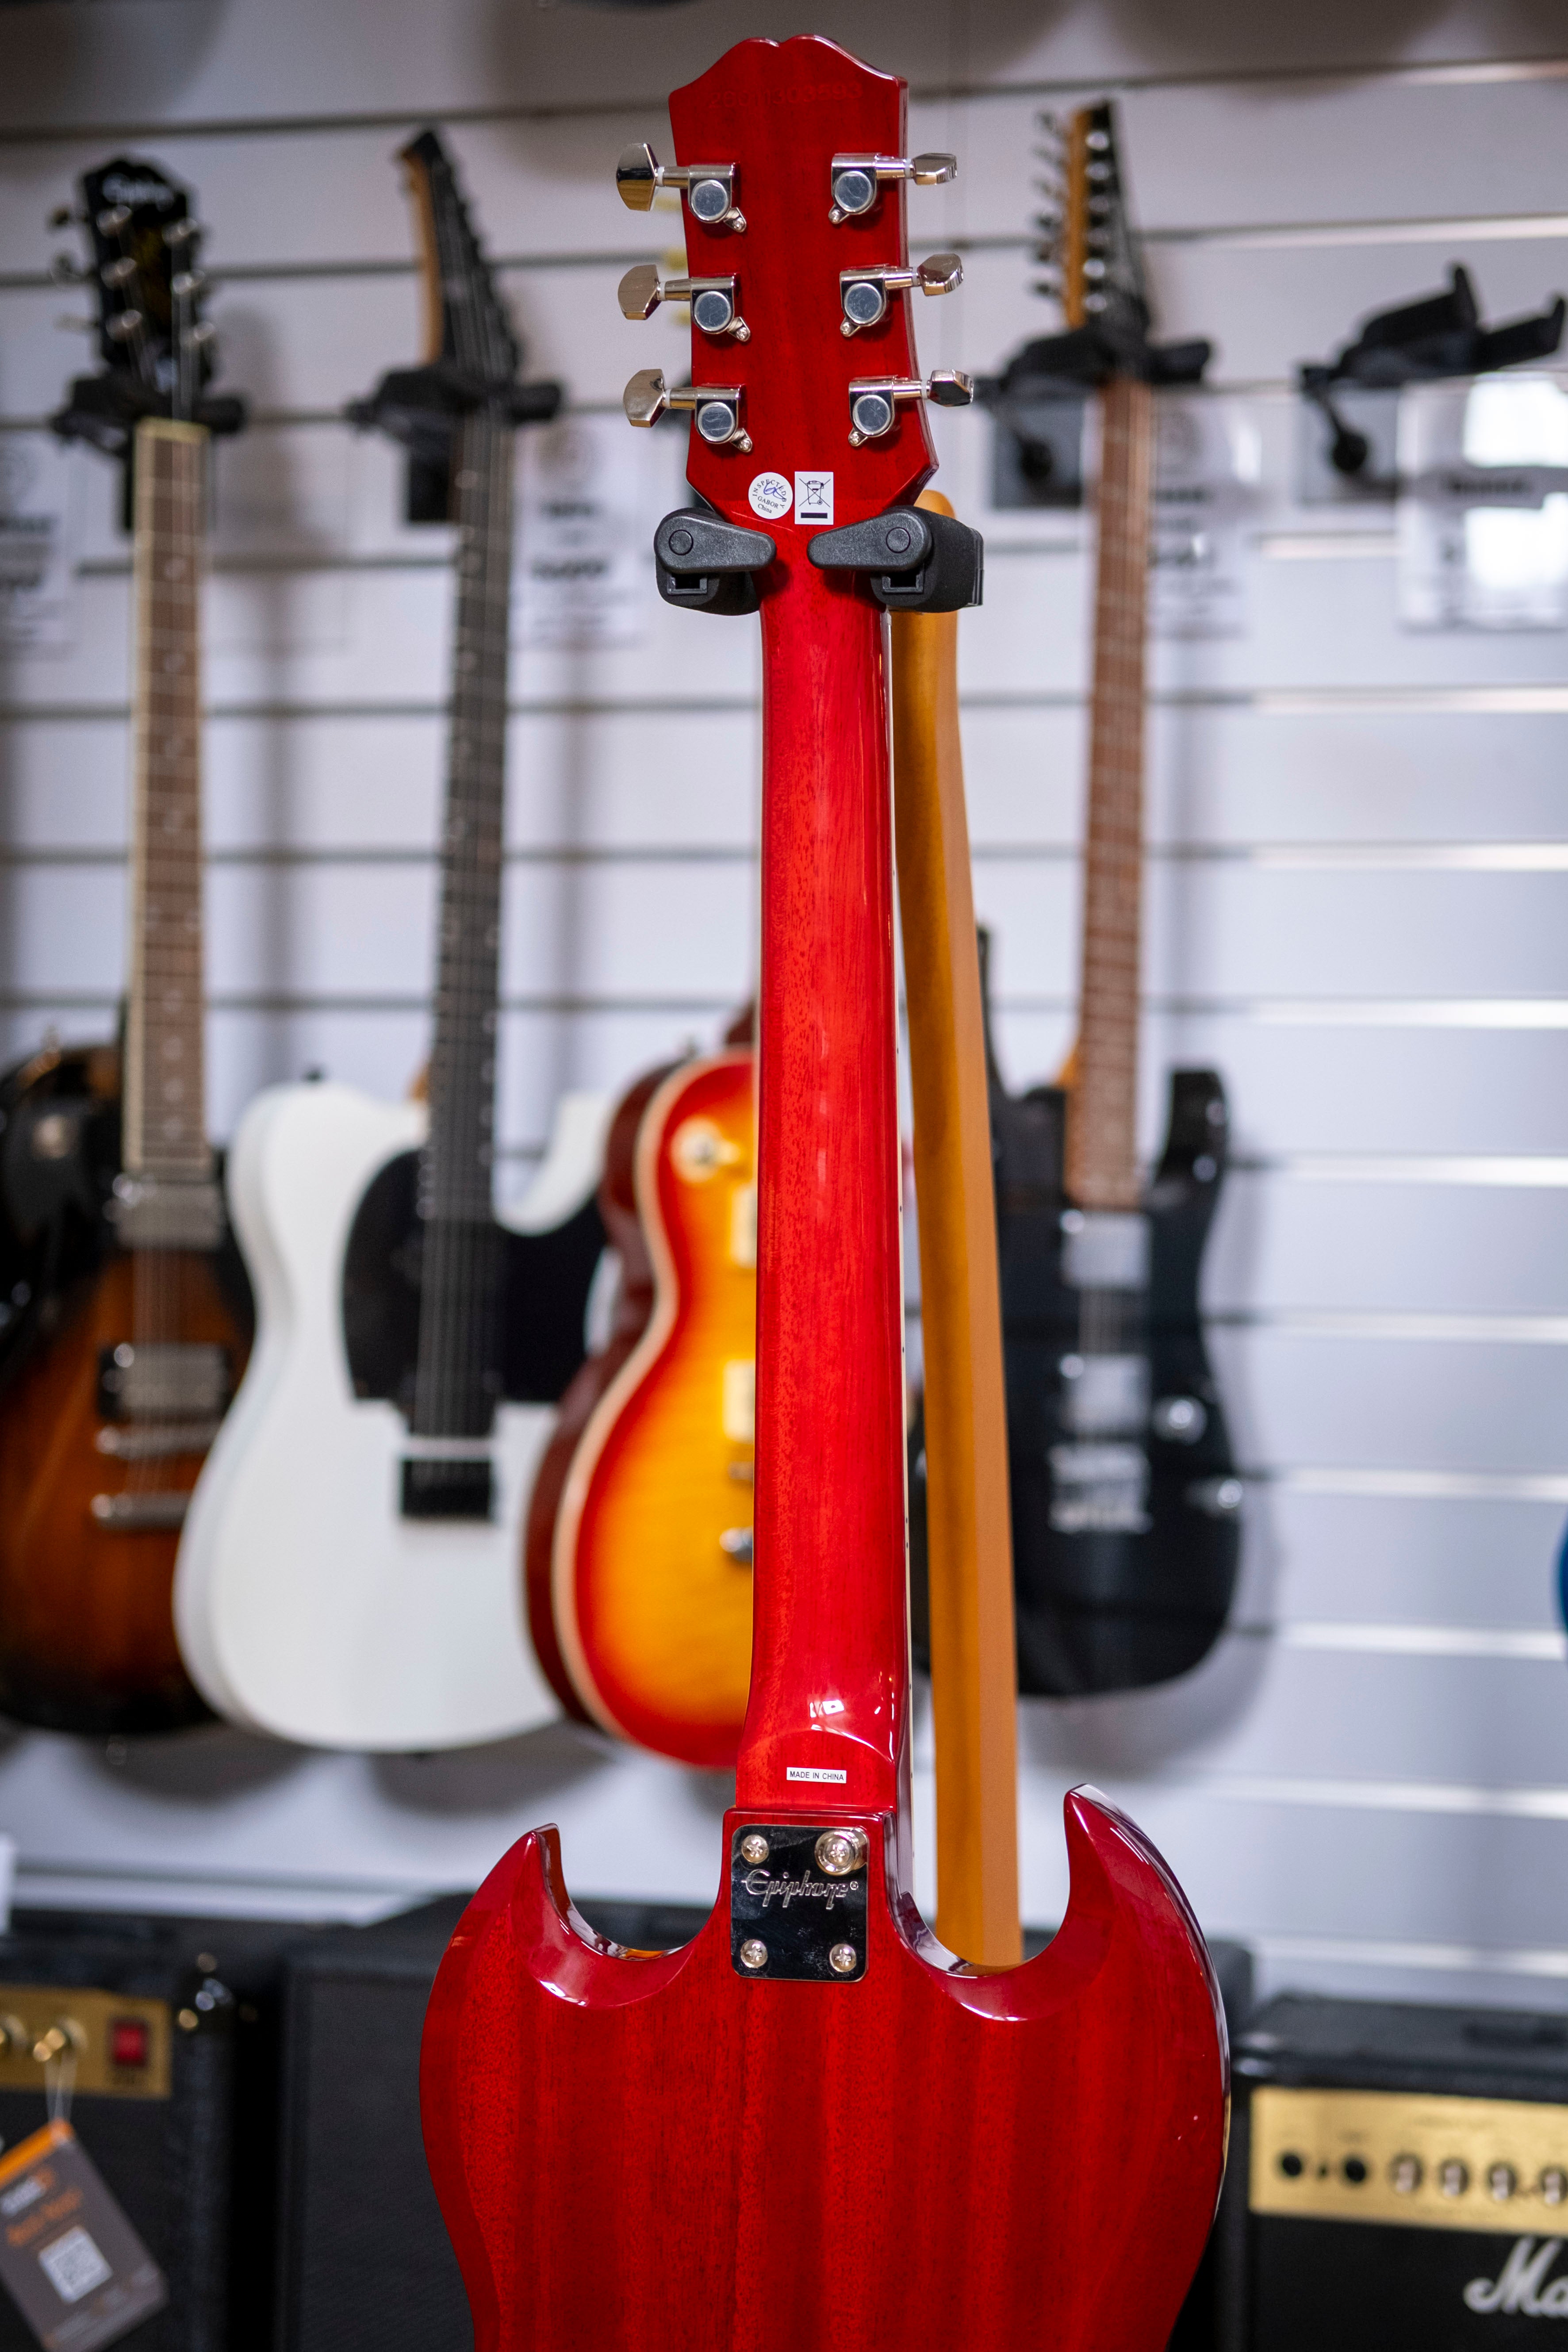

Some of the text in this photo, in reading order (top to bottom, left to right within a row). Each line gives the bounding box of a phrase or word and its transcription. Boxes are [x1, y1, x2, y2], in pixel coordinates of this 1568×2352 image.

[752, 479, 787, 509] INSPECTED BY
[757, 496, 779, 509] GABOR
[757, 503, 772, 513] China
